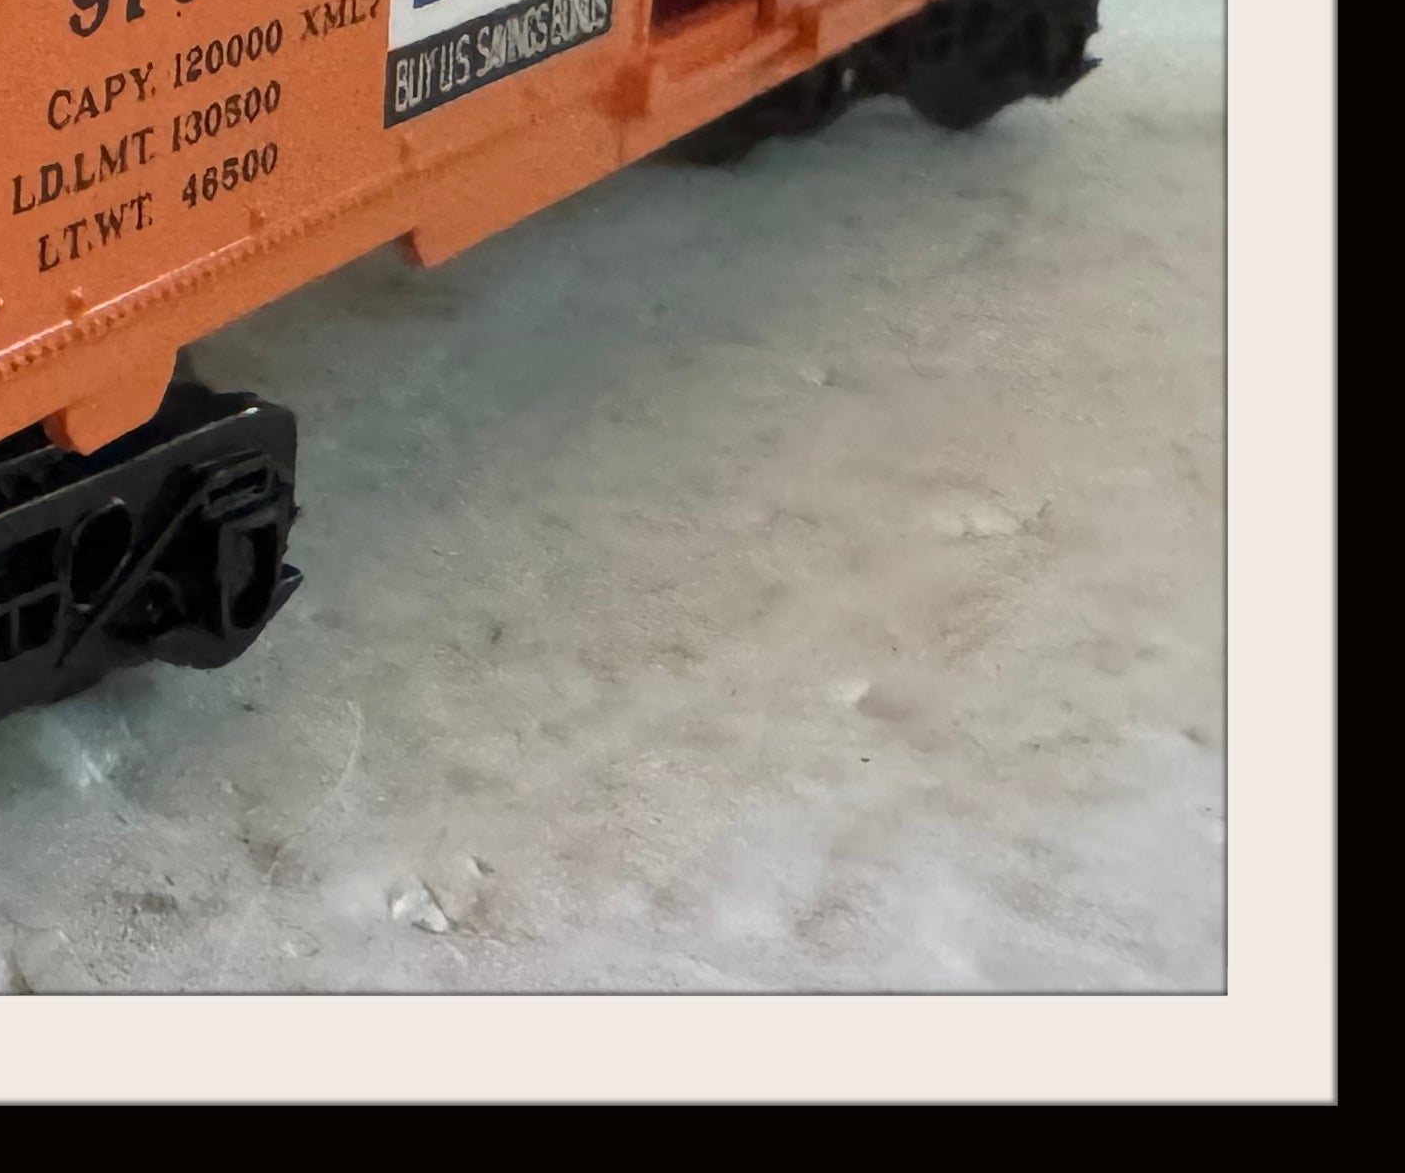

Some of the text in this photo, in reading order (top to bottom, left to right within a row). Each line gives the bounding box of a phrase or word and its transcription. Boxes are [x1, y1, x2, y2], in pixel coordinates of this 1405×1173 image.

[47, 62, 156, 130] CAPY.
[173, 19, 283, 88] 120000
[395, 46, 439, 112] BUY
[172, 80, 281, 152] 130500
[182, 142, 278, 210] 46500
